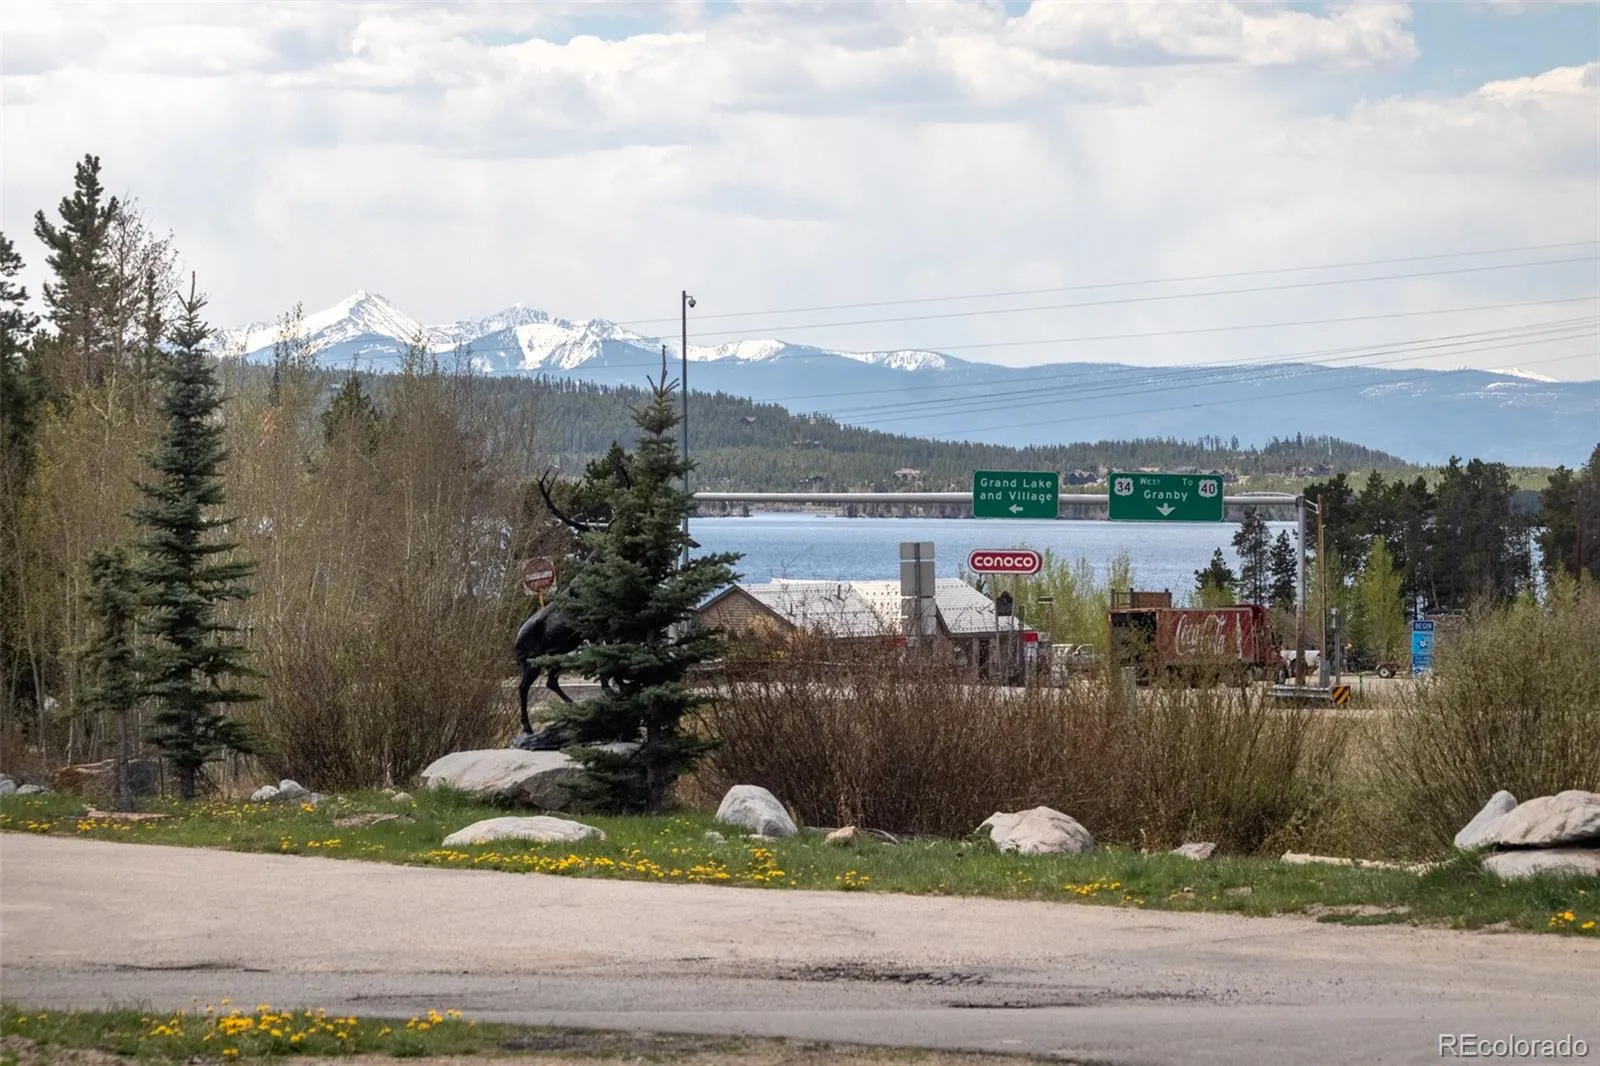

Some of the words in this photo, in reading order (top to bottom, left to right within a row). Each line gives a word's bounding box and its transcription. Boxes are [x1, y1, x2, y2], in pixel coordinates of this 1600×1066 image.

[980, 478, 1017, 488] Grand
[1023, 478, 1052, 488] Lake
[1116, 480, 1132, 493] 34
[1200, 483, 1216, 495] 40
[980, 491, 1002, 501] and
[1009, 491, 1052, 504] Village
[1144, 490, 1188, 502] Granby
